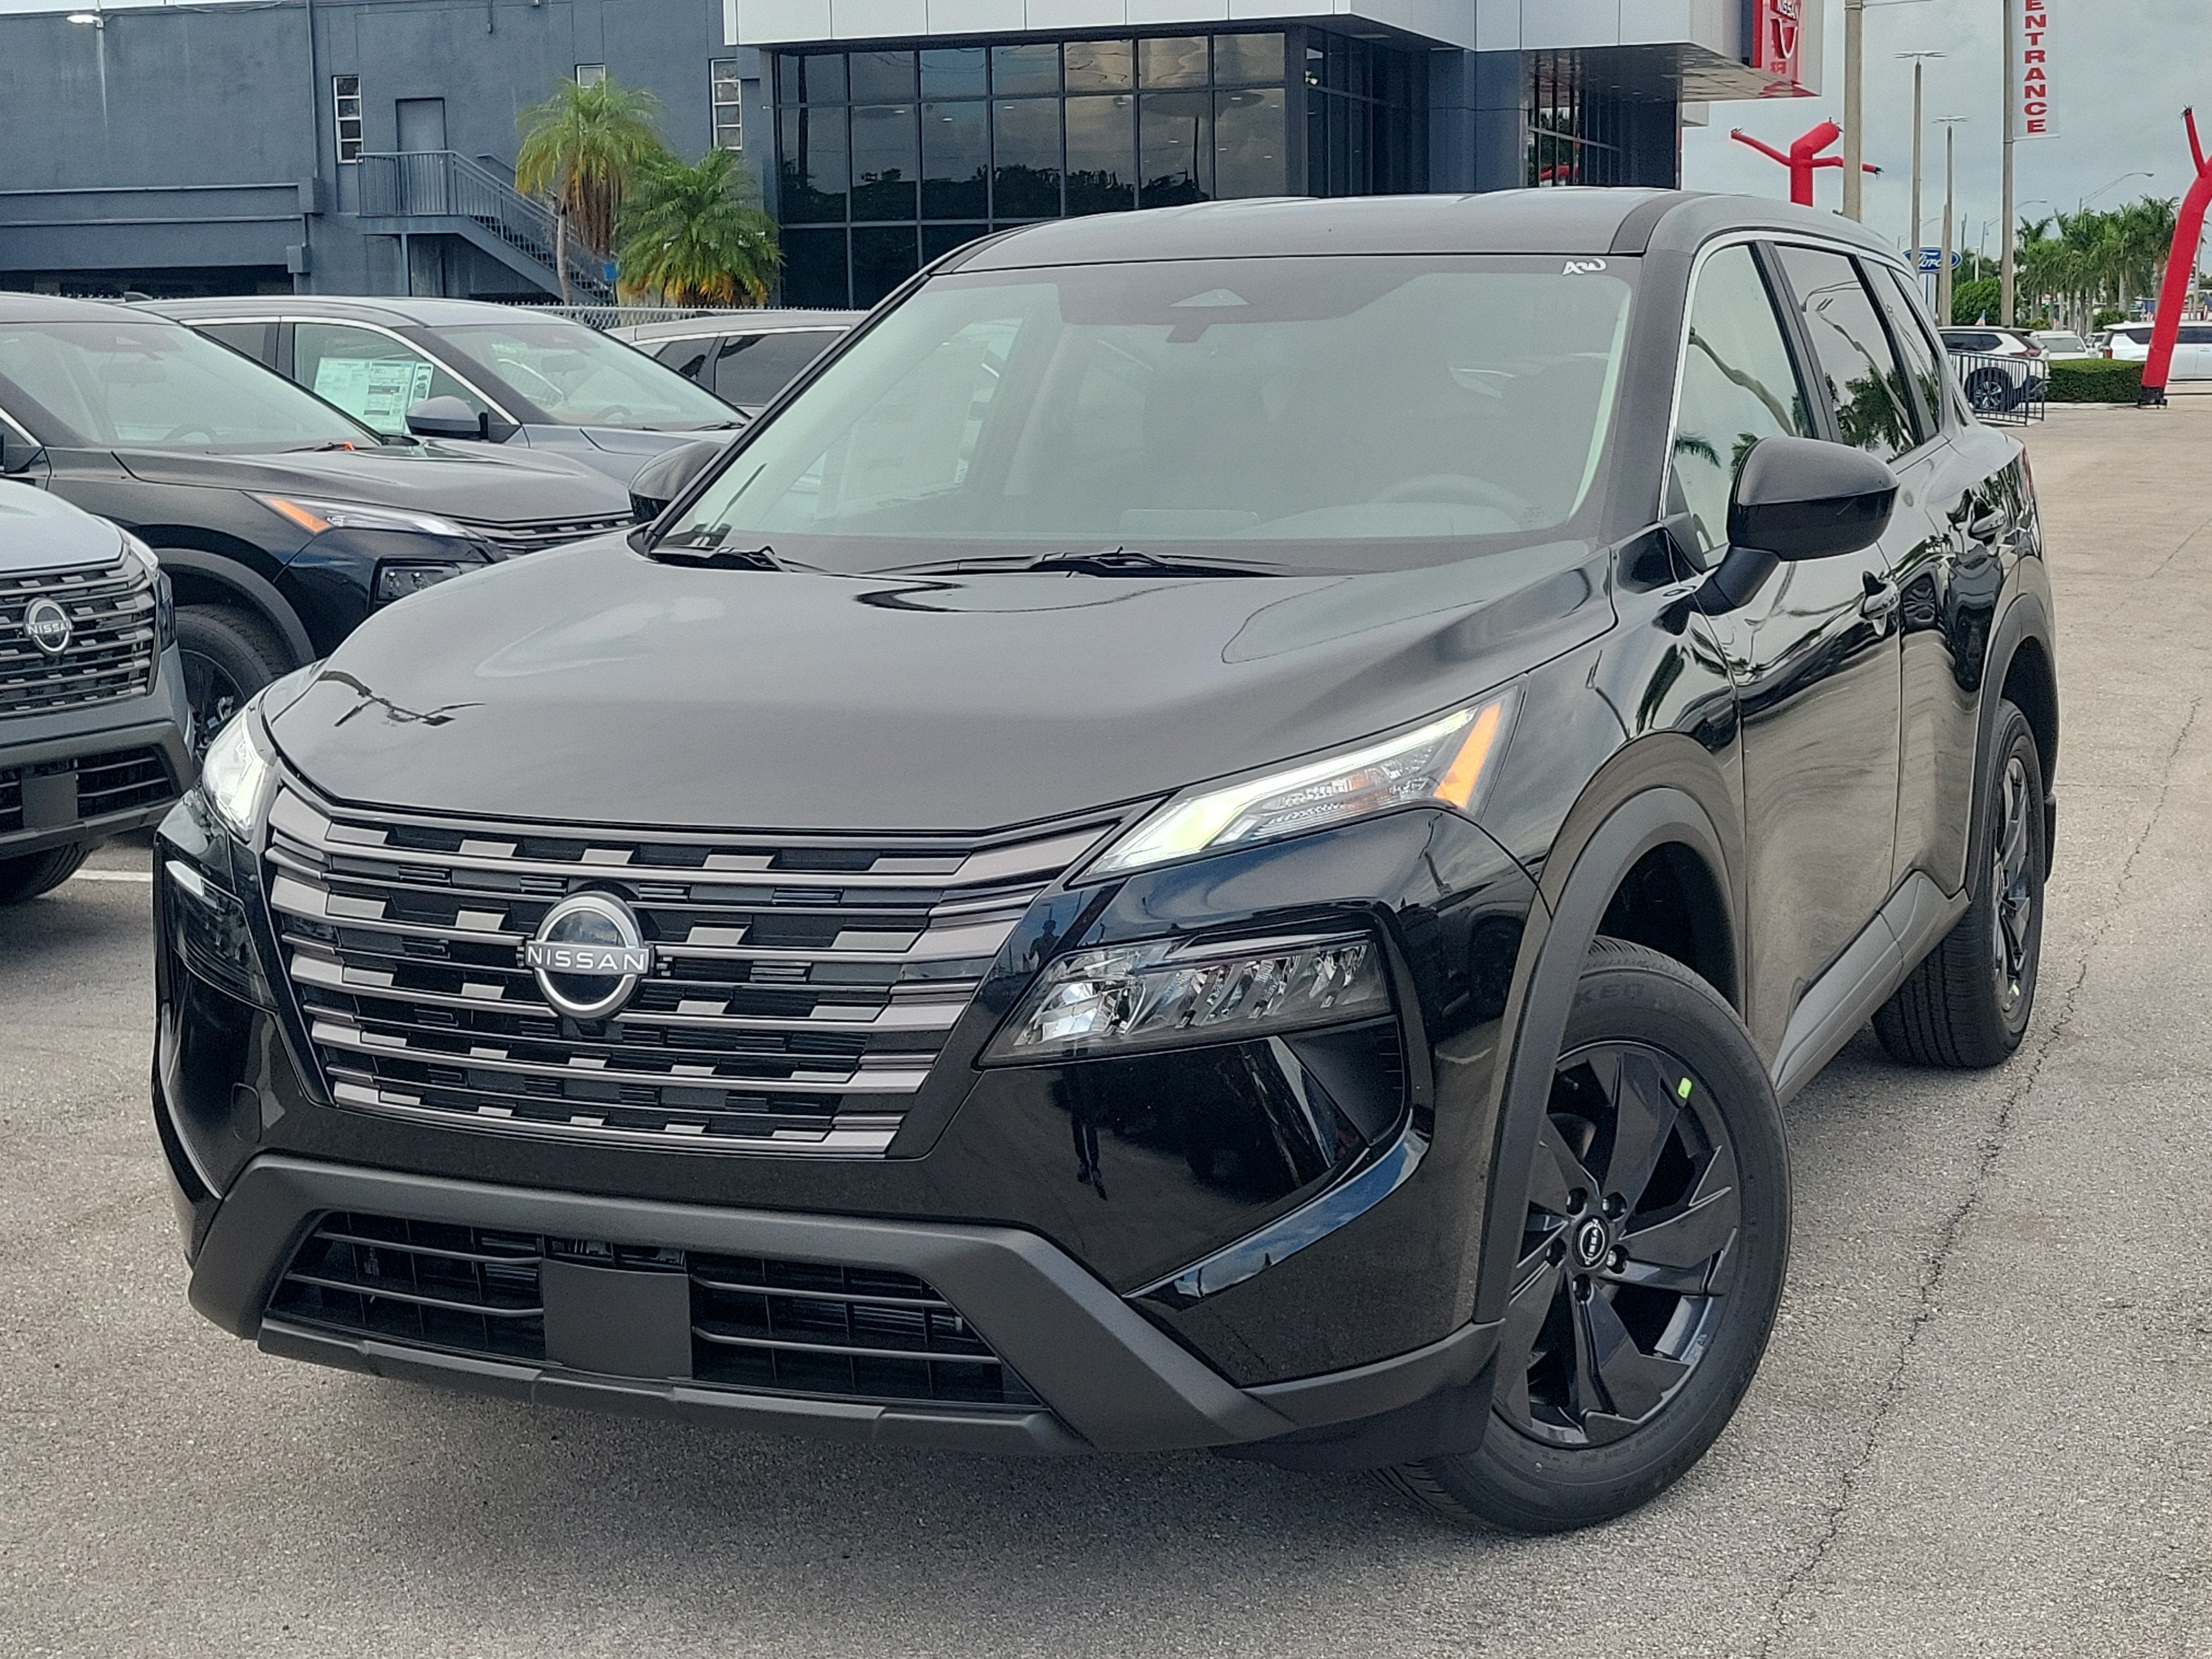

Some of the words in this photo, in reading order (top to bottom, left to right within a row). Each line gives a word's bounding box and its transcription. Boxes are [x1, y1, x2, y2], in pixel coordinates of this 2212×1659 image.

[2024, 0, 2047, 133] ENTRANCE
[27, 620, 73, 635] NISSAN
[527, 946, 644, 970] NISSAN
